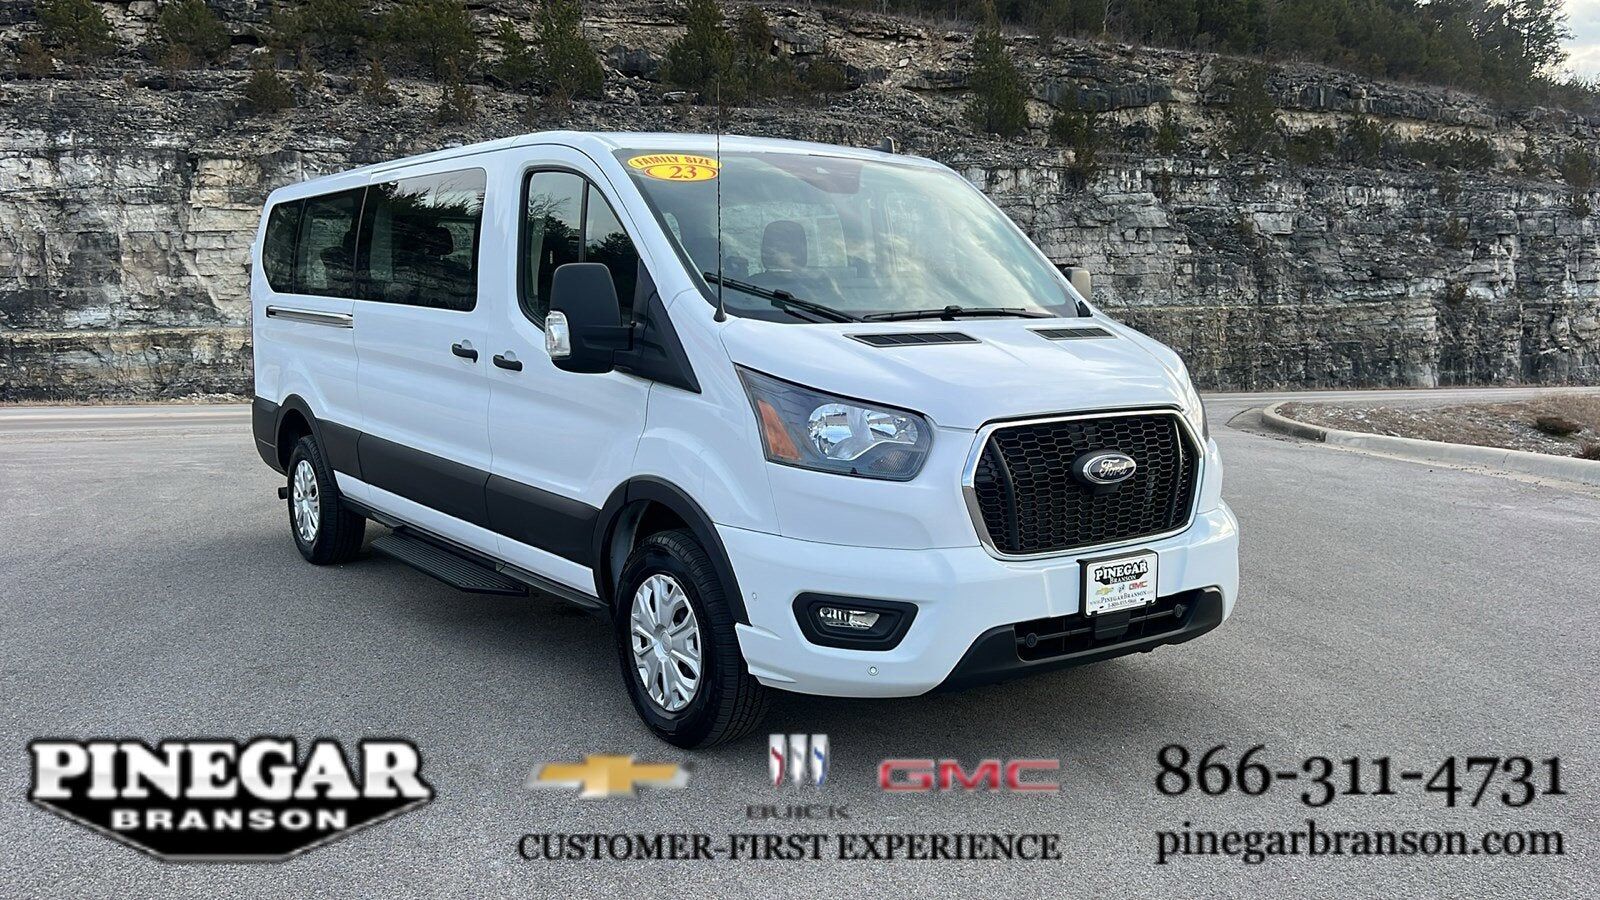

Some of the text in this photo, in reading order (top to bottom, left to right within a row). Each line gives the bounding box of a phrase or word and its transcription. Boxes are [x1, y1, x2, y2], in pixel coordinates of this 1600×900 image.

[636, 155, 712, 166] FAMILY SIZE
[669, 165, 698, 179] 23
[1099, 458, 1128, 478] Ford
[1095, 561, 1148, 580] PINEGAR
[1110, 575, 1137, 584] BRANSON
[1129, 580, 1148, 590] GMC
